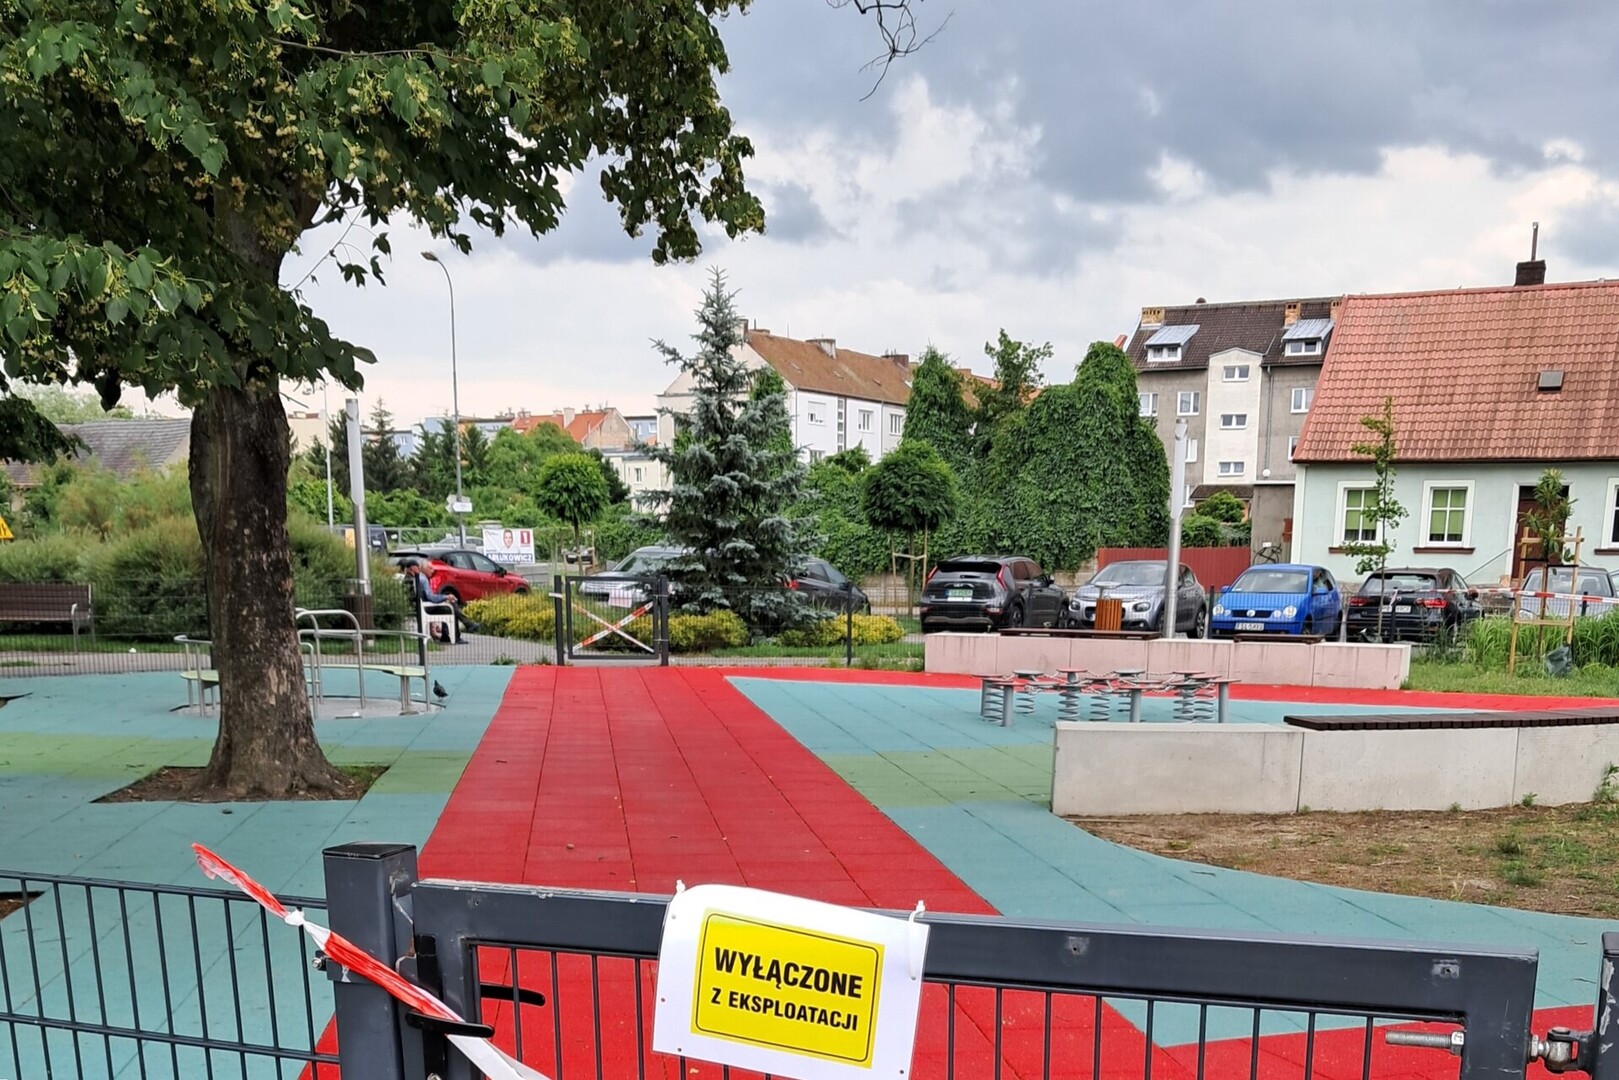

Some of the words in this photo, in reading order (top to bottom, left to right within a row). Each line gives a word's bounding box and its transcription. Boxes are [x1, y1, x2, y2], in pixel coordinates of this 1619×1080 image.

[715, 947, 863, 999] WYŁĄCZONE
[711, 987, 721, 1005] Z
[728, 991, 858, 1031] EKSPLOATACJI
